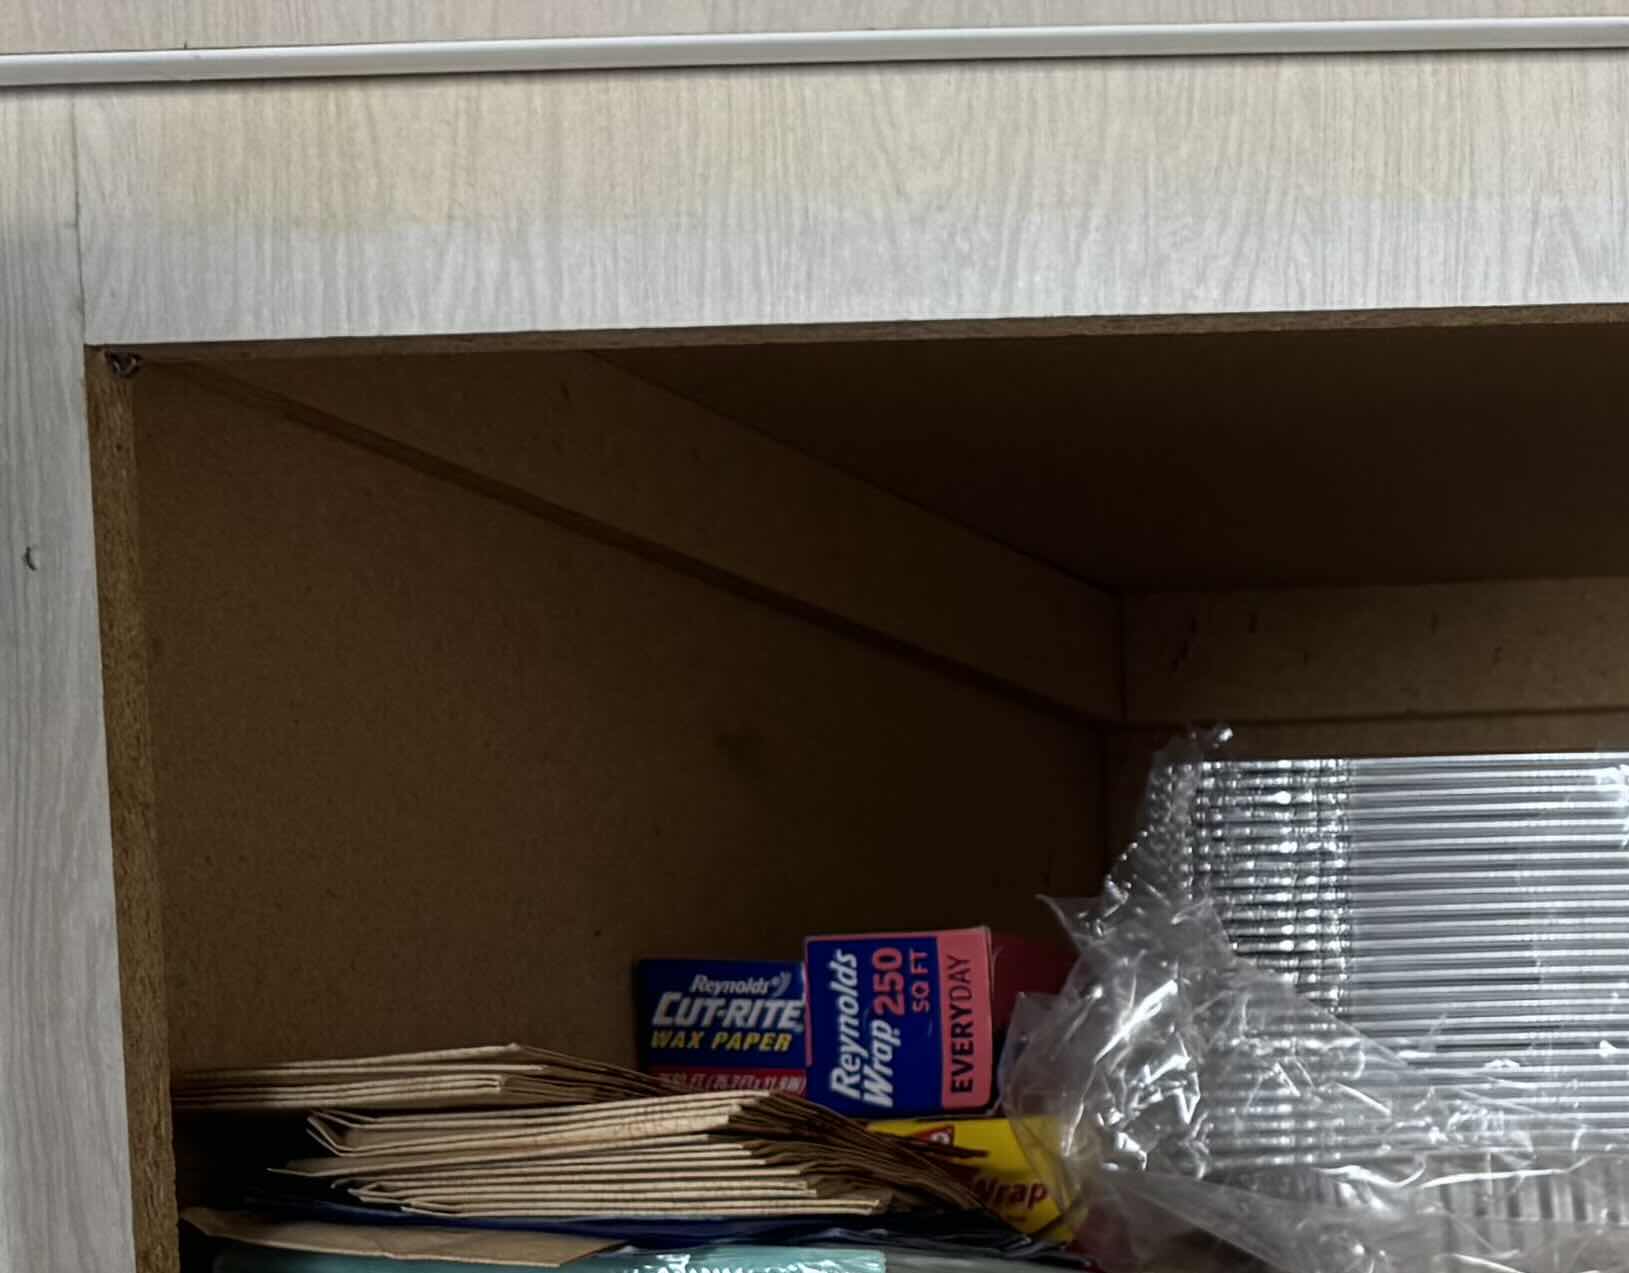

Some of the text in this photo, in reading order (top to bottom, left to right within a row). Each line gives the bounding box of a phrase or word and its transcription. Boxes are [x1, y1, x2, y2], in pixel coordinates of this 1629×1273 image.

[651, 991, 803, 1030] CUT-RITE
[690, 972, 768, 997] Reynolds
[871, 946, 906, 1017] 250
[908, 947, 931, 1014] SQ FT
[650, 1029, 793, 1053] WAX PAPER
[826, 948, 869, 1100] Reynolds
[947, 954, 974, 1094] EVERYDAY
